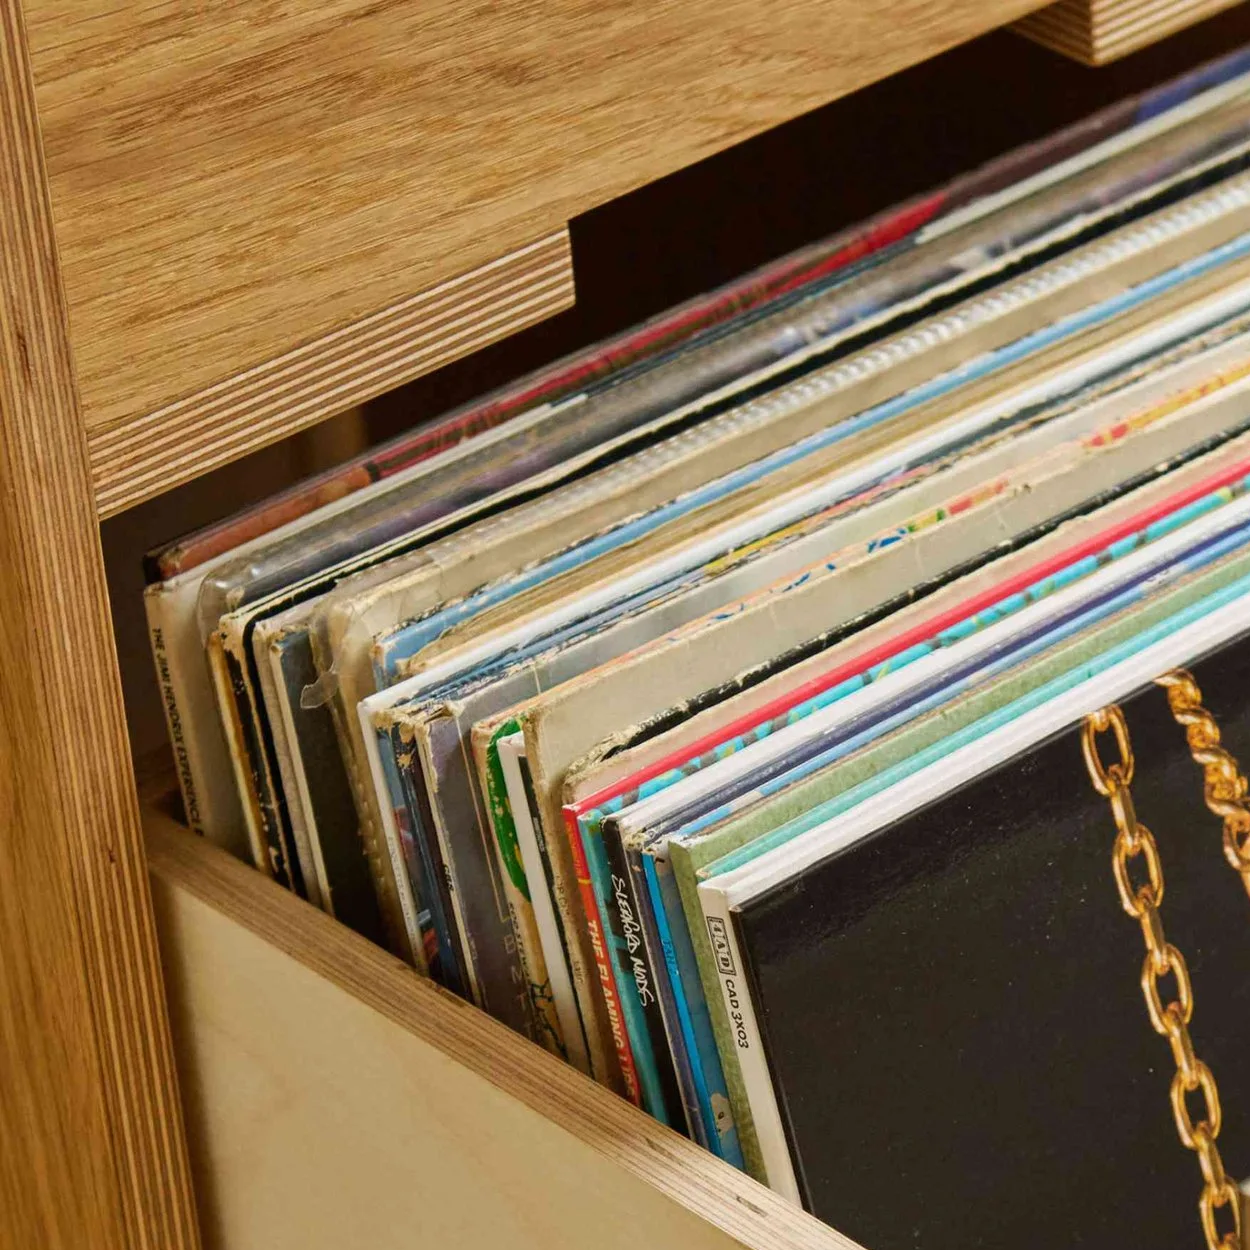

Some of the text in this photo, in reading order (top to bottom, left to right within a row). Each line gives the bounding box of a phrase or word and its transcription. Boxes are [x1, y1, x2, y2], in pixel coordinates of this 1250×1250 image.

[152, 628, 165, 650] THE
[157, 653, 170, 686] JIMI
[163, 684, 184, 744] HENDRIX
[177, 745, 202, 825] EXPERIENCE
[588, 919, 604, 958] THE
[597, 963, 624, 1049] FLAMING
[630, 956, 654, 1006] MODS
[725, 979, 739, 1009] CAD
